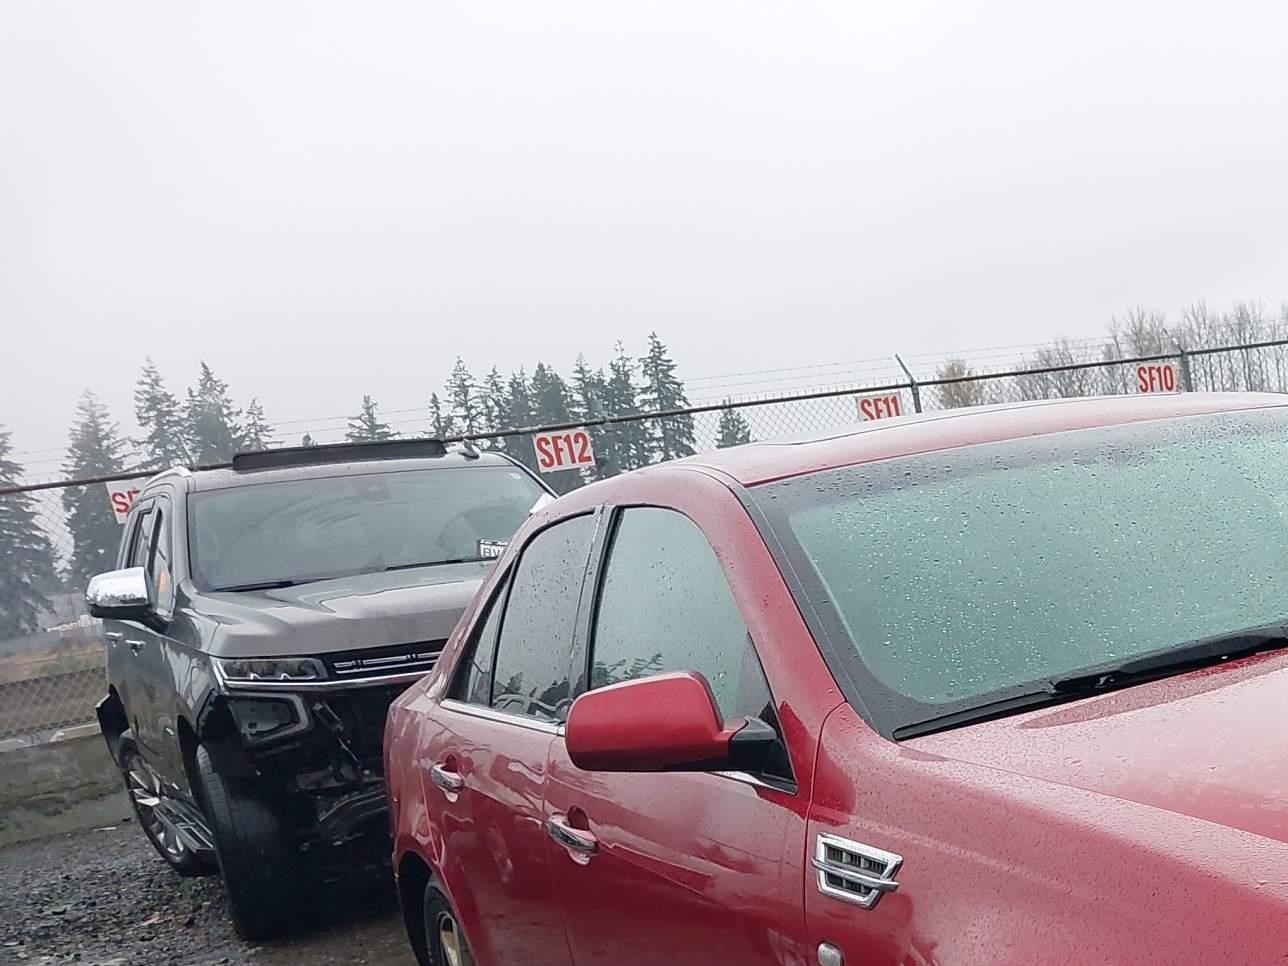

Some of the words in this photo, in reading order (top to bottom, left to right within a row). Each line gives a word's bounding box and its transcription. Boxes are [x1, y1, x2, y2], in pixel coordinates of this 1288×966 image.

[1137, 365, 1174, 393] SF10
[860, 395, 901, 422] SF11
[536, 432, 592, 468] SF12
